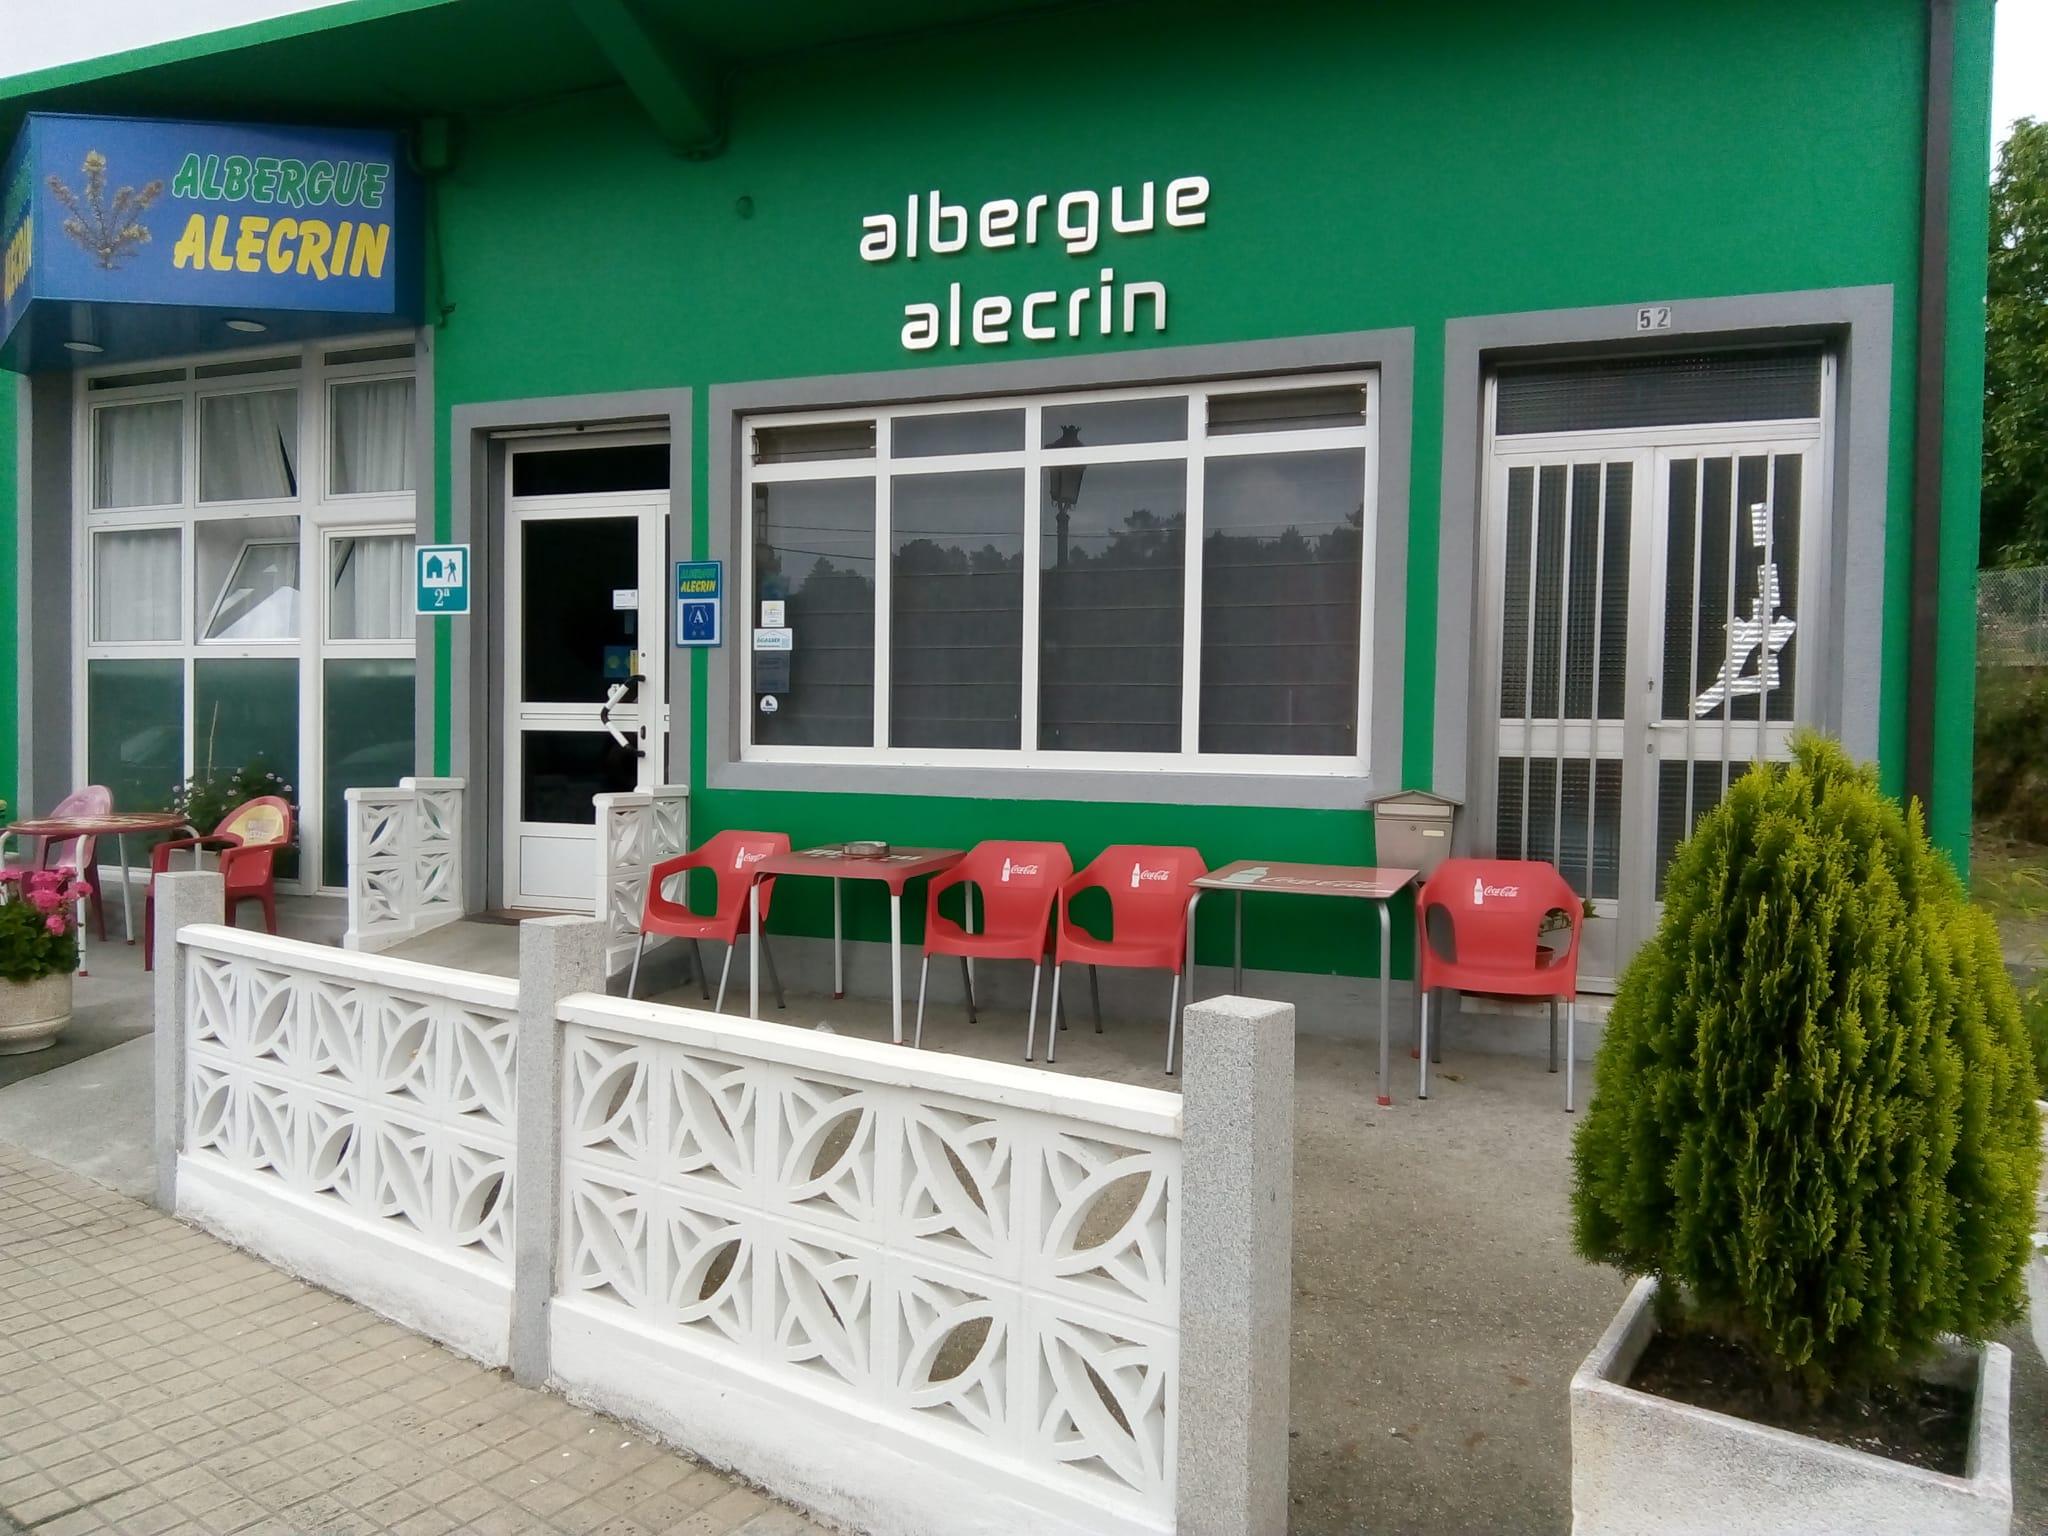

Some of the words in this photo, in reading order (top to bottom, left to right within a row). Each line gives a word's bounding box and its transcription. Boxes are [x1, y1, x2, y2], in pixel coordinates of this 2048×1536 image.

[172, 153, 390, 209] ALBERGUE
[173, 213, 391, 281] ALECRIN
[859, 175, 1210, 261] albergue
[901, 267, 1166, 350] alecrin
[1640, 309, 1668, 329] 52
[693, 609, 704, 624] A
